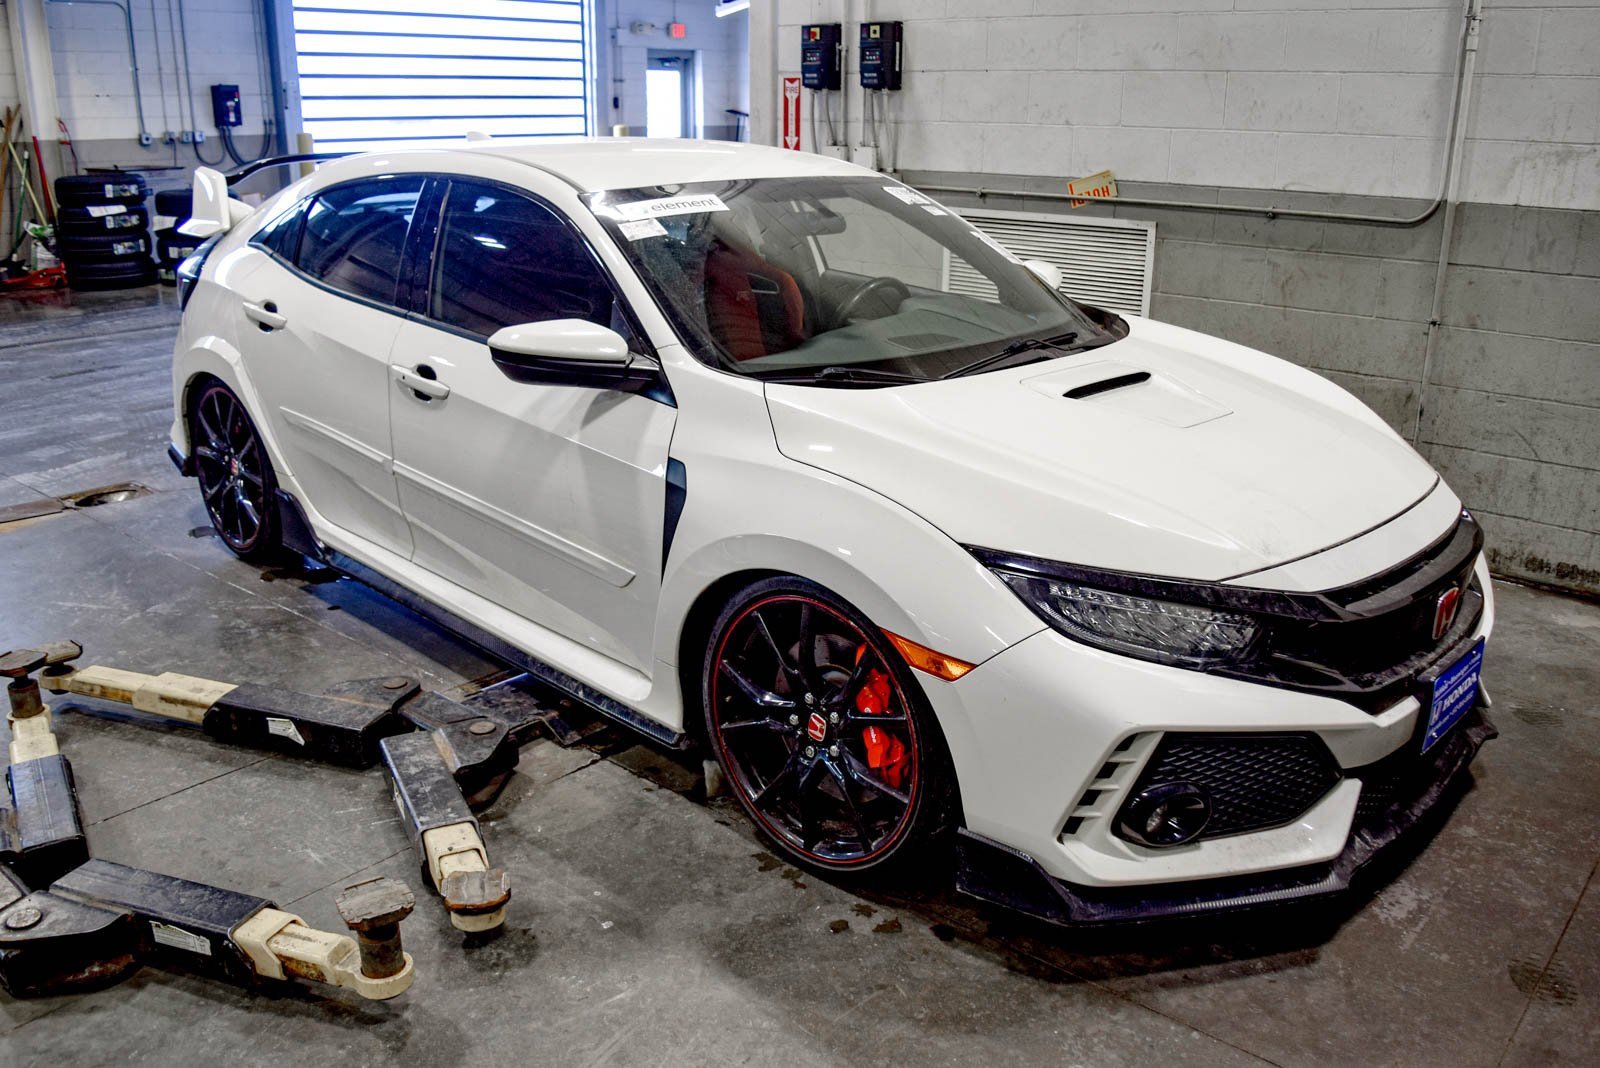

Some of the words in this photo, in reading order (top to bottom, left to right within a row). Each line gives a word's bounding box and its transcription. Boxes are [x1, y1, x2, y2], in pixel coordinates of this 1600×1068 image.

[786, 86, 798, 94] FIRE
[651, 197, 719, 212] element
[1442, 672, 1478, 712] HONDA
